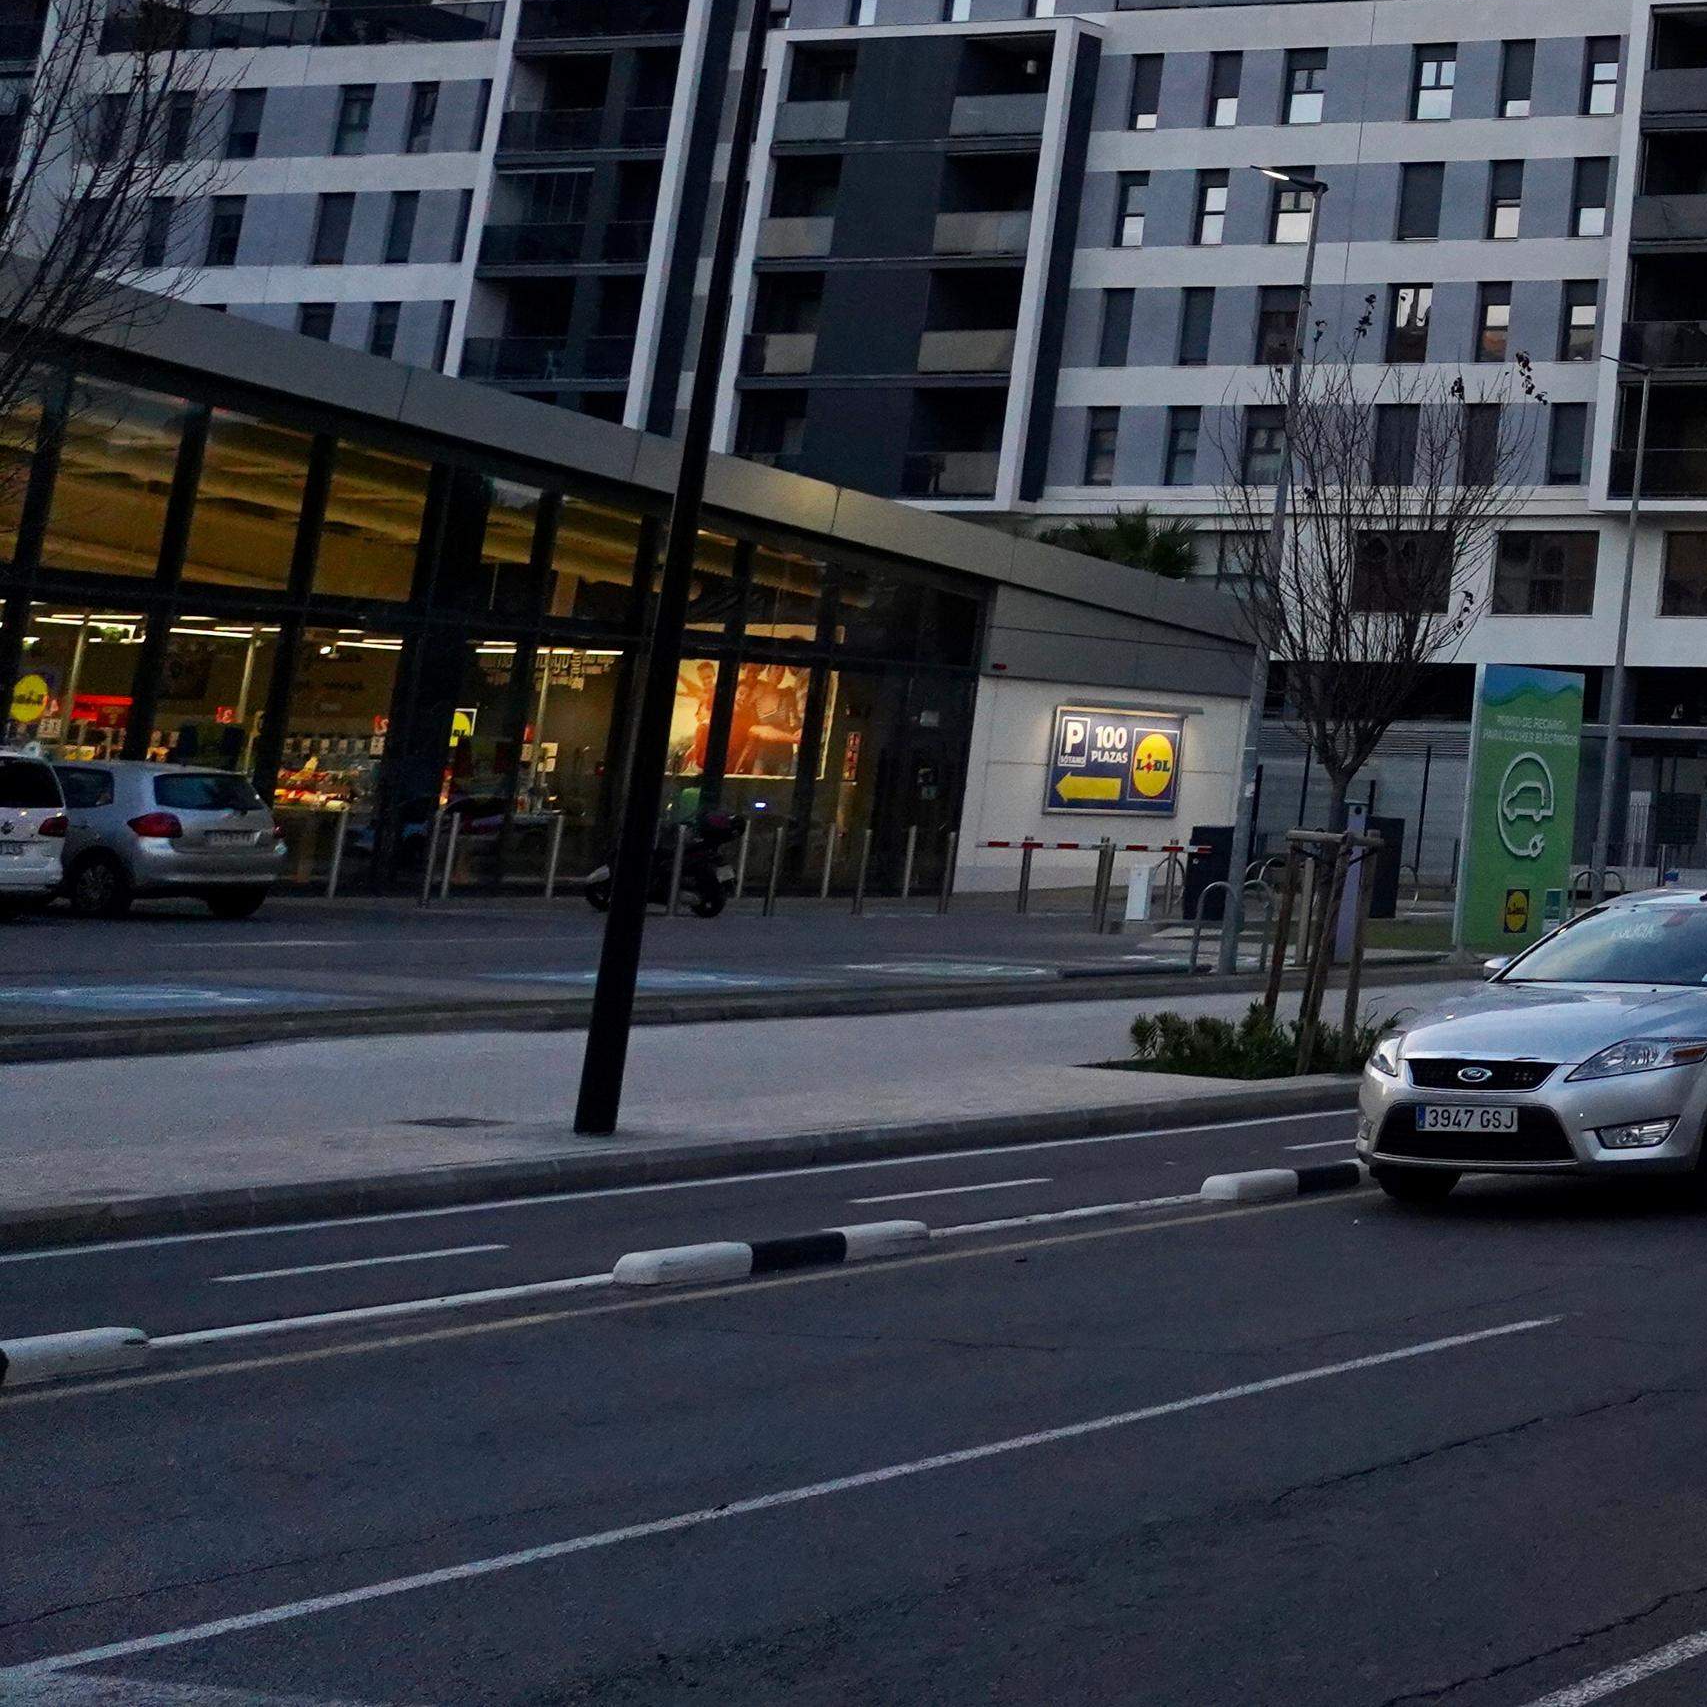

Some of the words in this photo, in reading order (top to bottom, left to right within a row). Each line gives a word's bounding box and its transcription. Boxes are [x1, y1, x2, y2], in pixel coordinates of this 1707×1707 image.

[1064, 721, 1085, 754] P
[1095, 725, 1128, 749] 100
[1091, 750, 1129, 764] PLAZAS
[1428, 1108, 1475, 1129] 3947
[1480, 1109, 1514, 1130] GSJ
